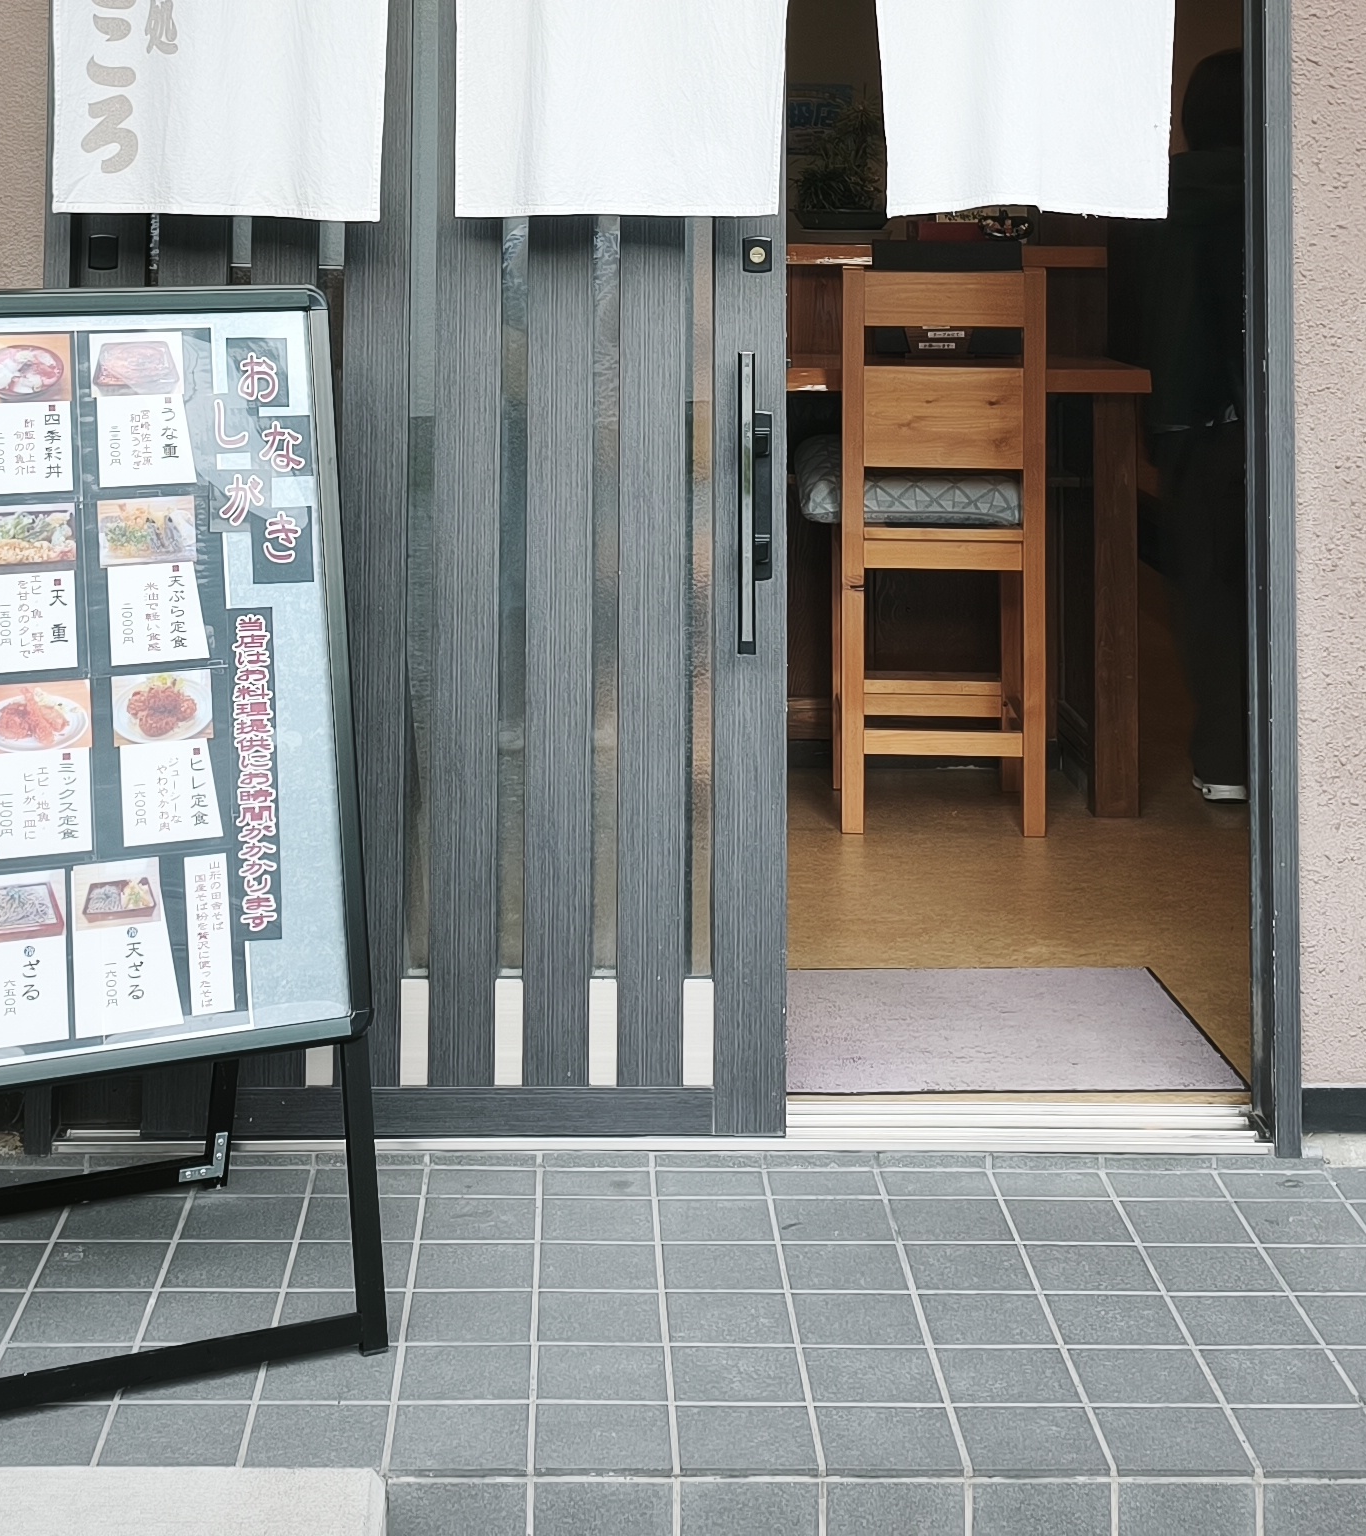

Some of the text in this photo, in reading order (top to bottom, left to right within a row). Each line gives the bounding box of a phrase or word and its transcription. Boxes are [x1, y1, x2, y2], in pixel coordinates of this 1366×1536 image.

[14, 430, 26, 476] 旬の魚介
[43, 413, 63, 479] 四季彩丼
[160, 407, 180, 460] うな重
[213, 351, 306, 564] おしながき
[57, 762, 80, 841] ミックス定食
[190, 757, 210, 827] ヒレ定食
[233, 613, 277, 932] 当店はお料理提供にお時間がかかります
[209, 860, 225, 931] 山形の田舎そば
[22, 958, 41, 1001] ざる
[125, 941, 145, 1000] 天ざる
